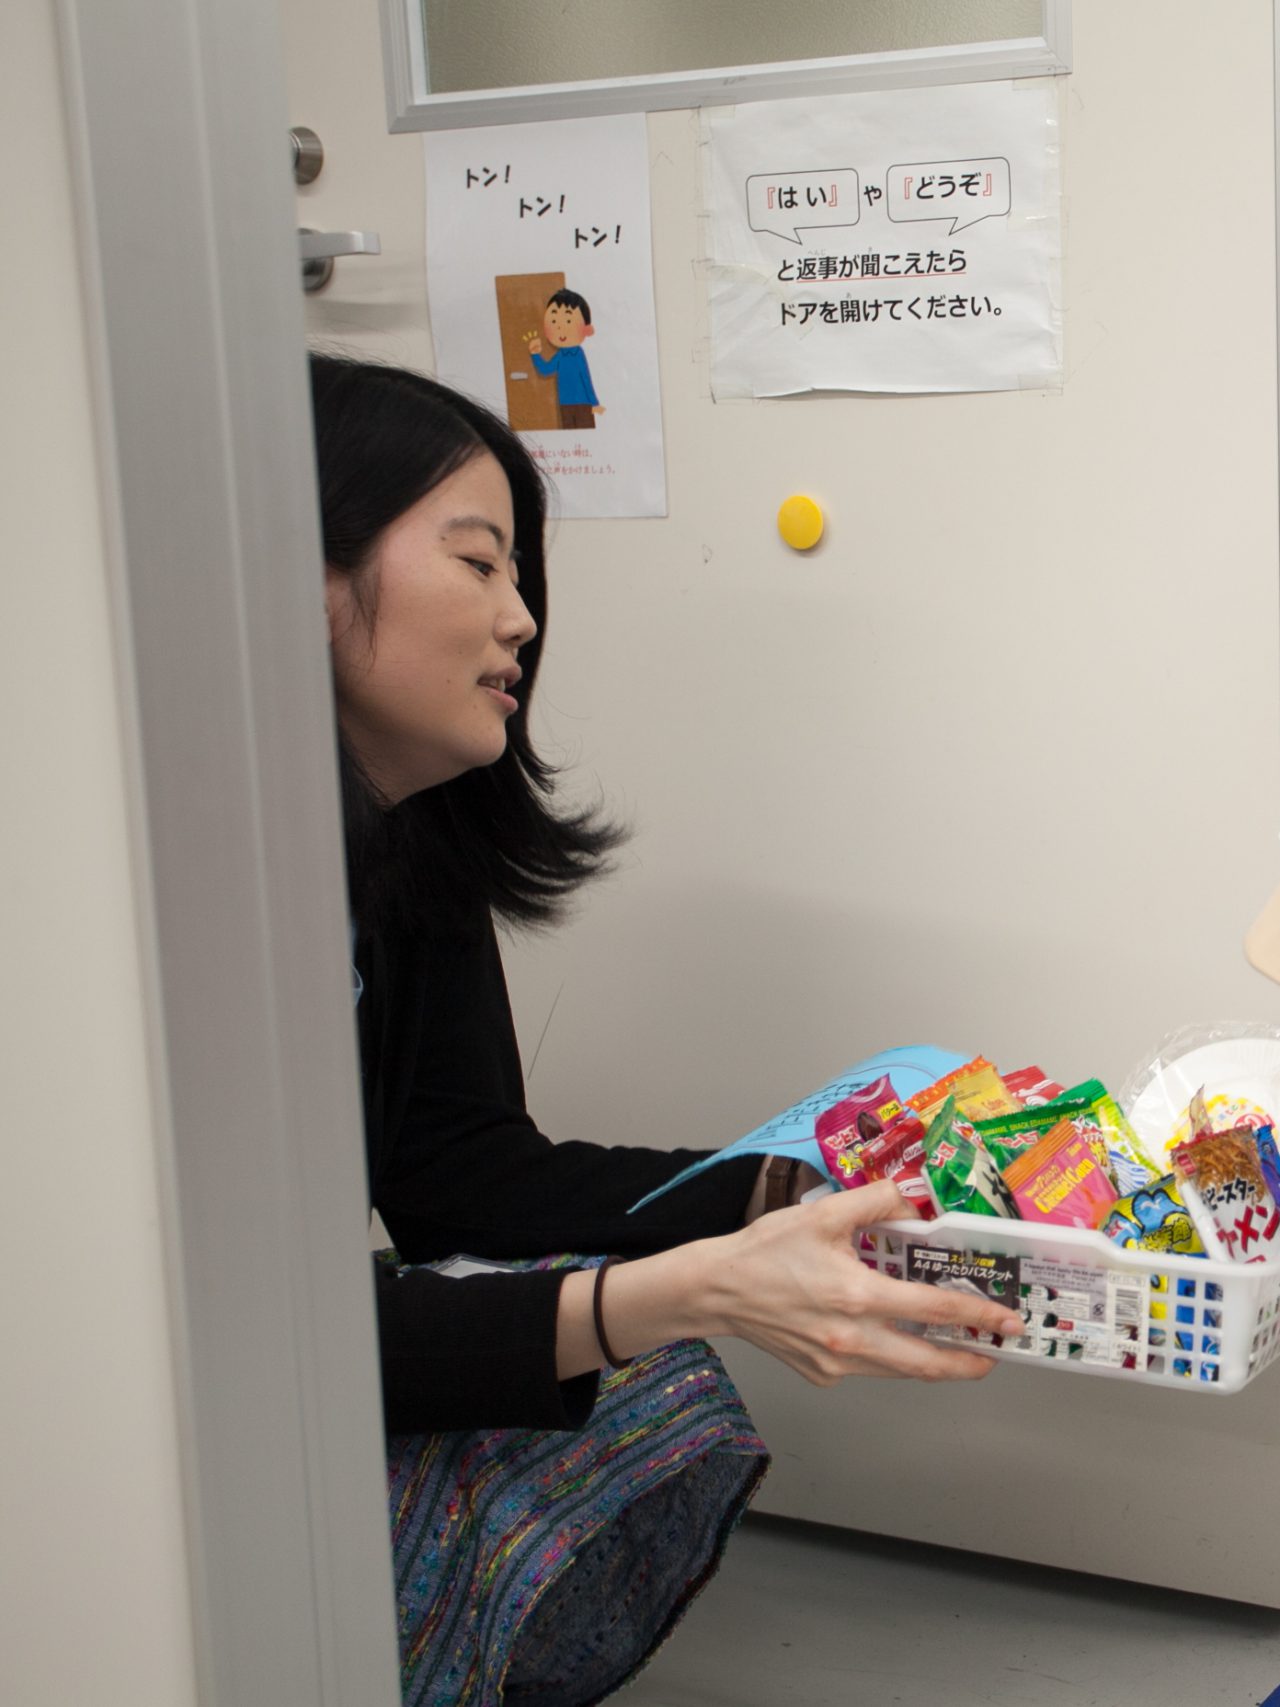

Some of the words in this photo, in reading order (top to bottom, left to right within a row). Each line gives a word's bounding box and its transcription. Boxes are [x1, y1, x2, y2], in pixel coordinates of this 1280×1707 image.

[466, 165, 511, 189] トン！
[863, 185, 883, 207] や
[904, 172, 993, 201] 『どうぞ』
[519, 194, 566, 219] トン！
[575, 225, 621, 249] トン！
[776, 249, 968, 282] と返事が聞こえたら
[780, 295, 1003, 326] ドアを開けてください。
